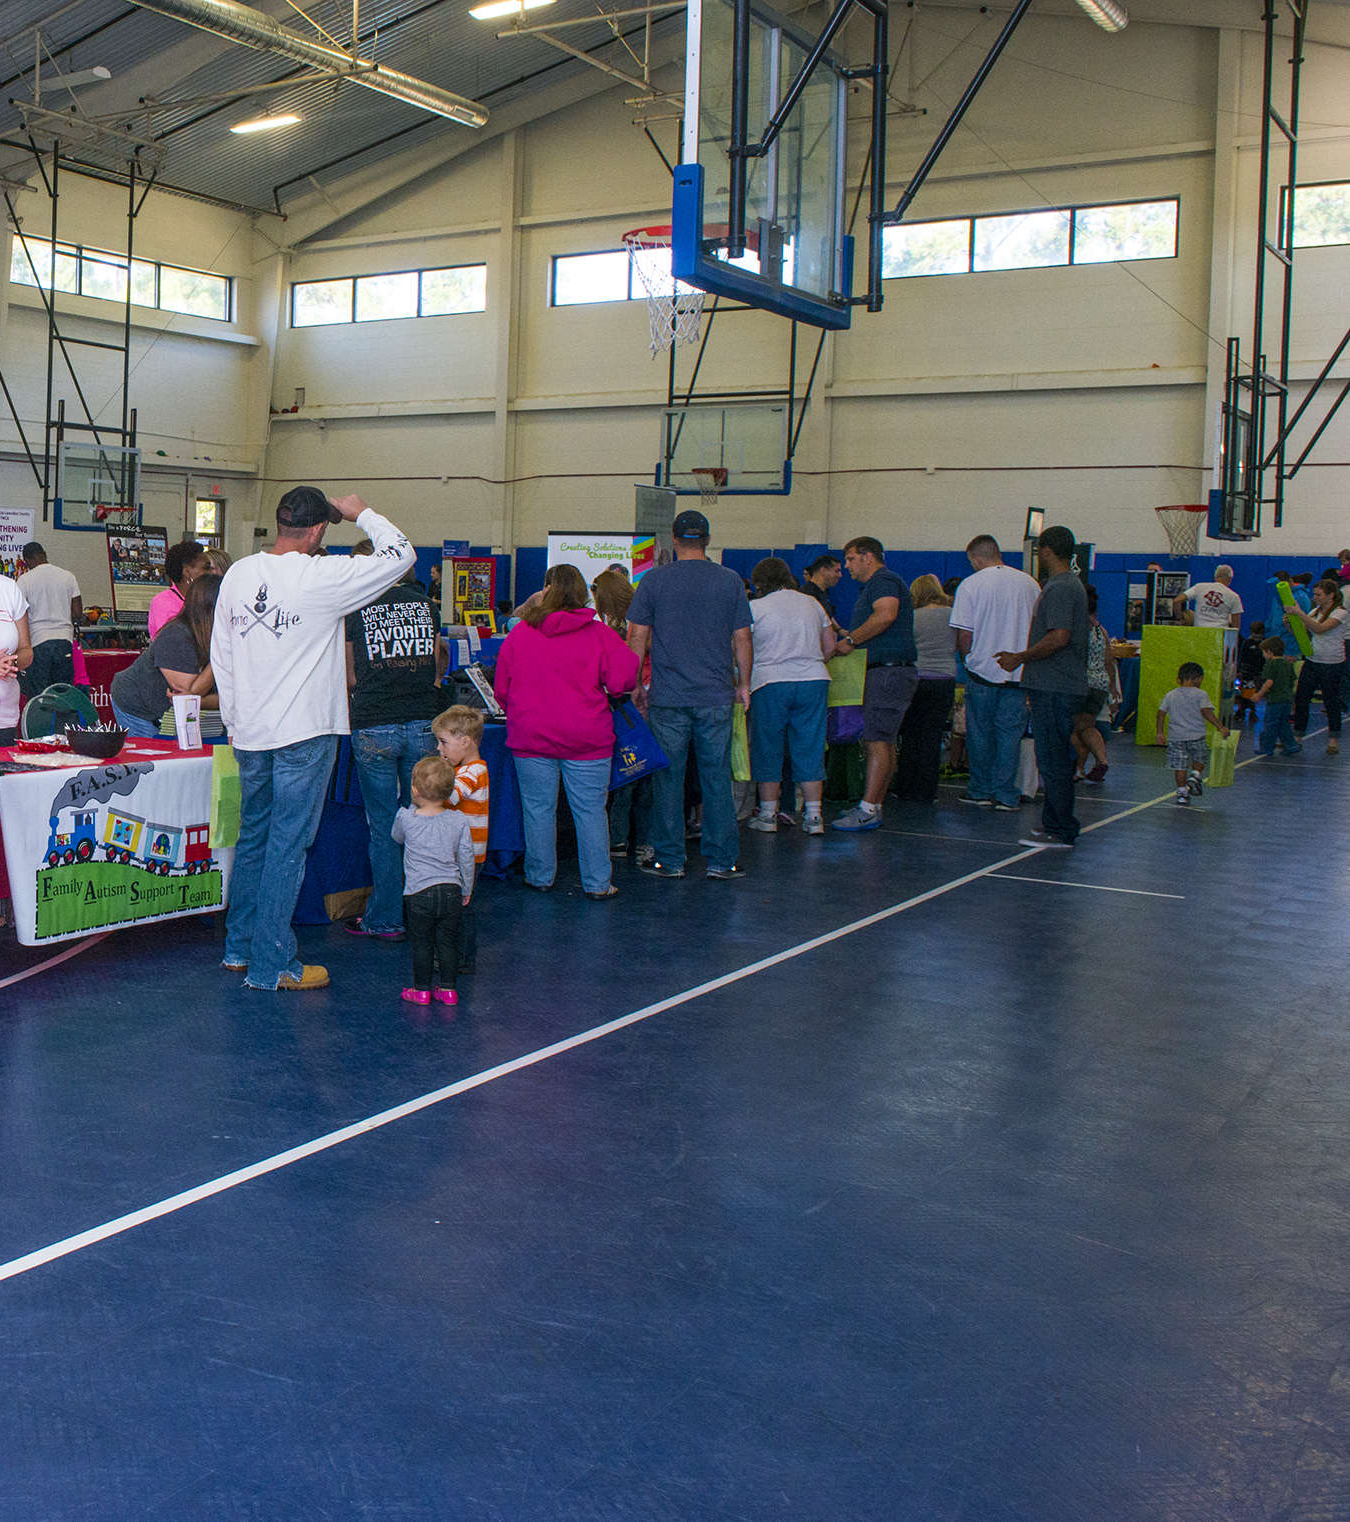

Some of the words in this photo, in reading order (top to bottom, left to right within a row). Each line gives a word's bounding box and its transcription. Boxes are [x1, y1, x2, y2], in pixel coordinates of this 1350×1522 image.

[560, 542, 591, 554] Creating
[593, 542, 627, 551] Solutions
[588, 552, 623, 560] Changing
[361, 604, 390, 617] MOST
[393, 602, 430, 611] PEOPLE
[362, 612, 385, 623] WILL
[386, 610, 415, 619] NEVER
[364, 621, 377, 631] TO
[379, 618, 405, 628] MEET
[407, 616, 433, 625] THEIR
[364, 624, 434, 644] FAVORITE
[366, 638, 434, 660] PLAYER
[43, 877, 83, 898] Family
[85, 880, 126, 901] Autism
[130, 881, 175, 902] Support
[178, 885, 211, 905] Team
